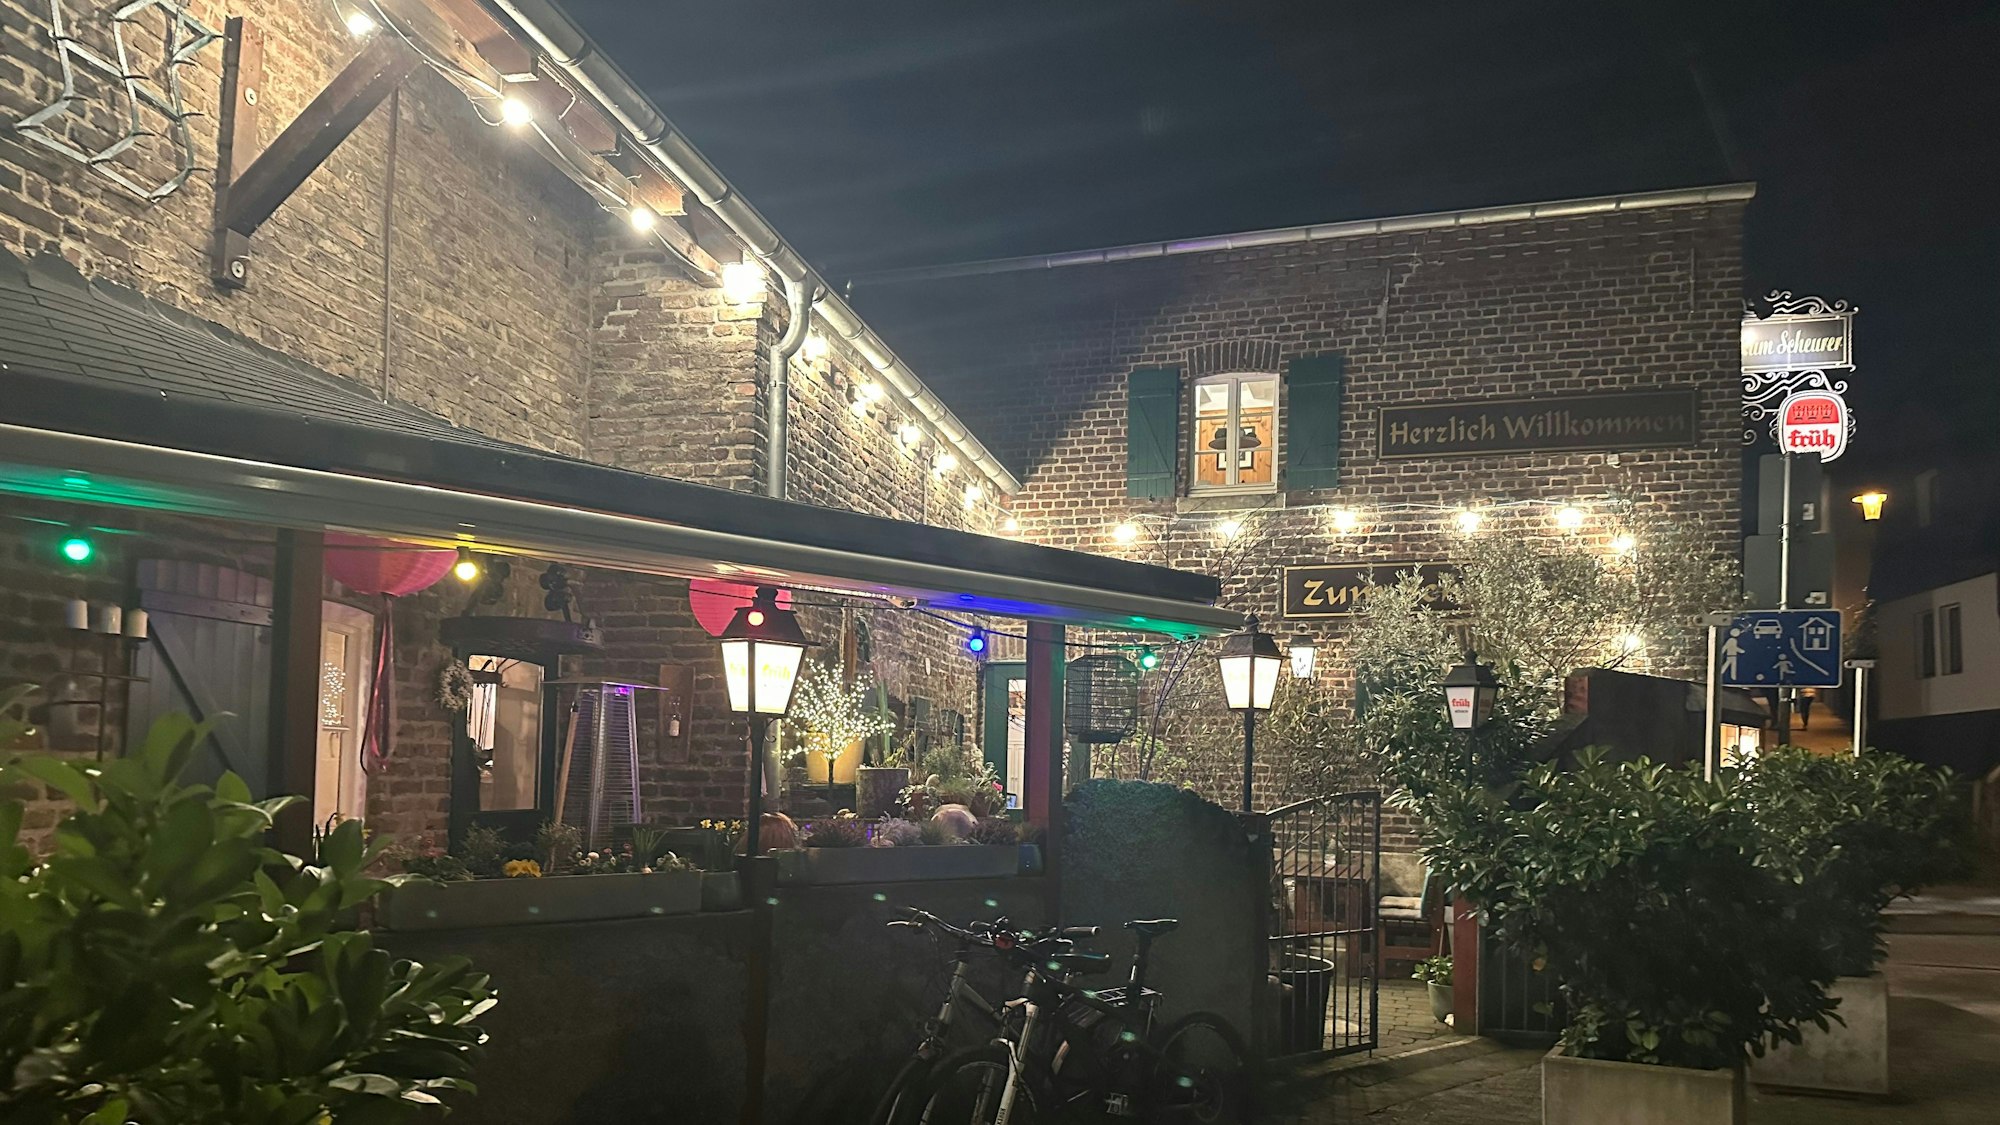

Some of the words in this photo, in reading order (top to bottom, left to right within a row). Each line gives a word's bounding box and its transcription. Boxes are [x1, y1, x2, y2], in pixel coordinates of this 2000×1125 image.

[1742, 335, 1774, 357] um
[1776, 329, 1843, 355] Scheurer
[1389, 413, 1496, 446] Herzlich
[1502, 408, 1685, 440] Willkommen
[1788, 429, 1836, 449] früh
